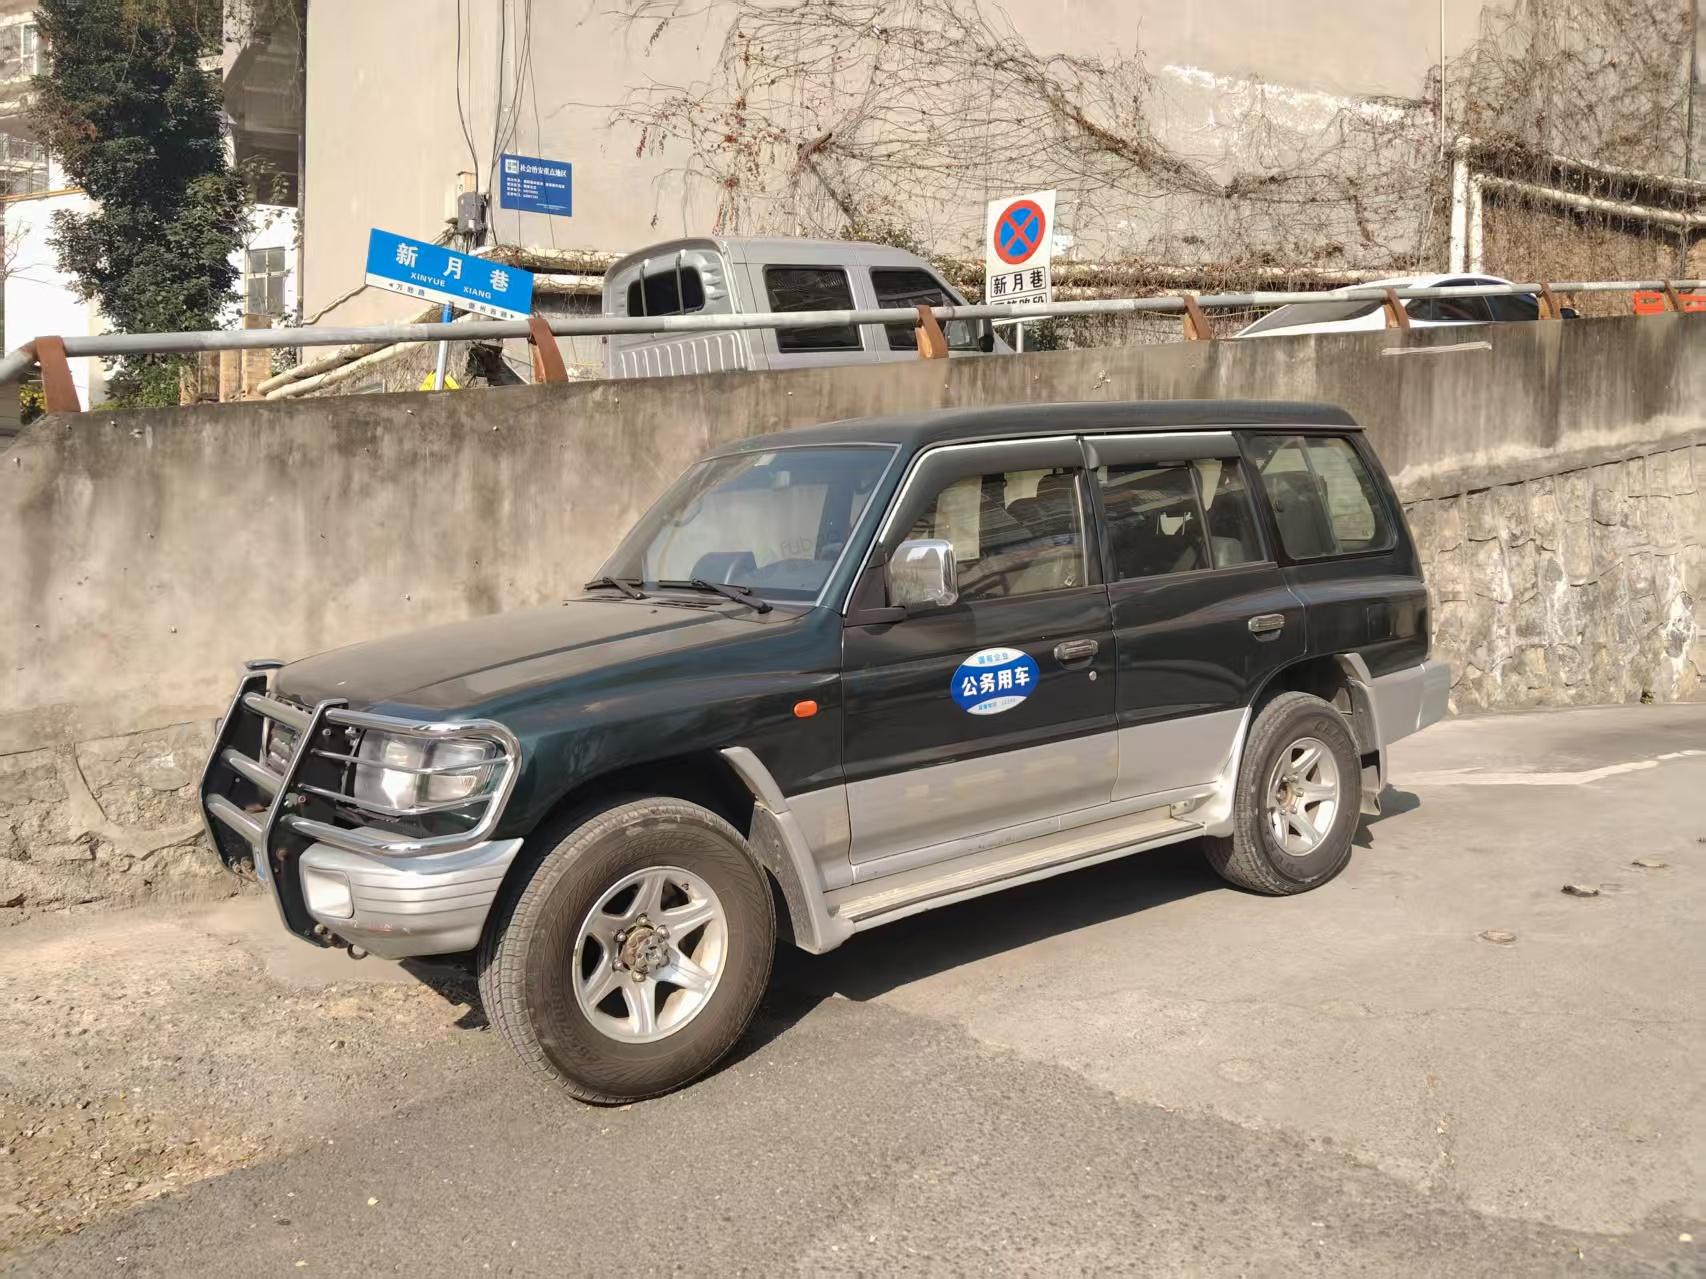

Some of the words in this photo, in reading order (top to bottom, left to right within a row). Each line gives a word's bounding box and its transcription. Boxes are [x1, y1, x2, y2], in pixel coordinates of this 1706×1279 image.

[395, 242, 510, 293] 新月巷
[410, 272, 446, 287] XINYUE
[463, 286, 492, 300] XIANG
[993, 270, 1043, 295] 新月巷
[962, 666, 1030, 697] 公务用车
